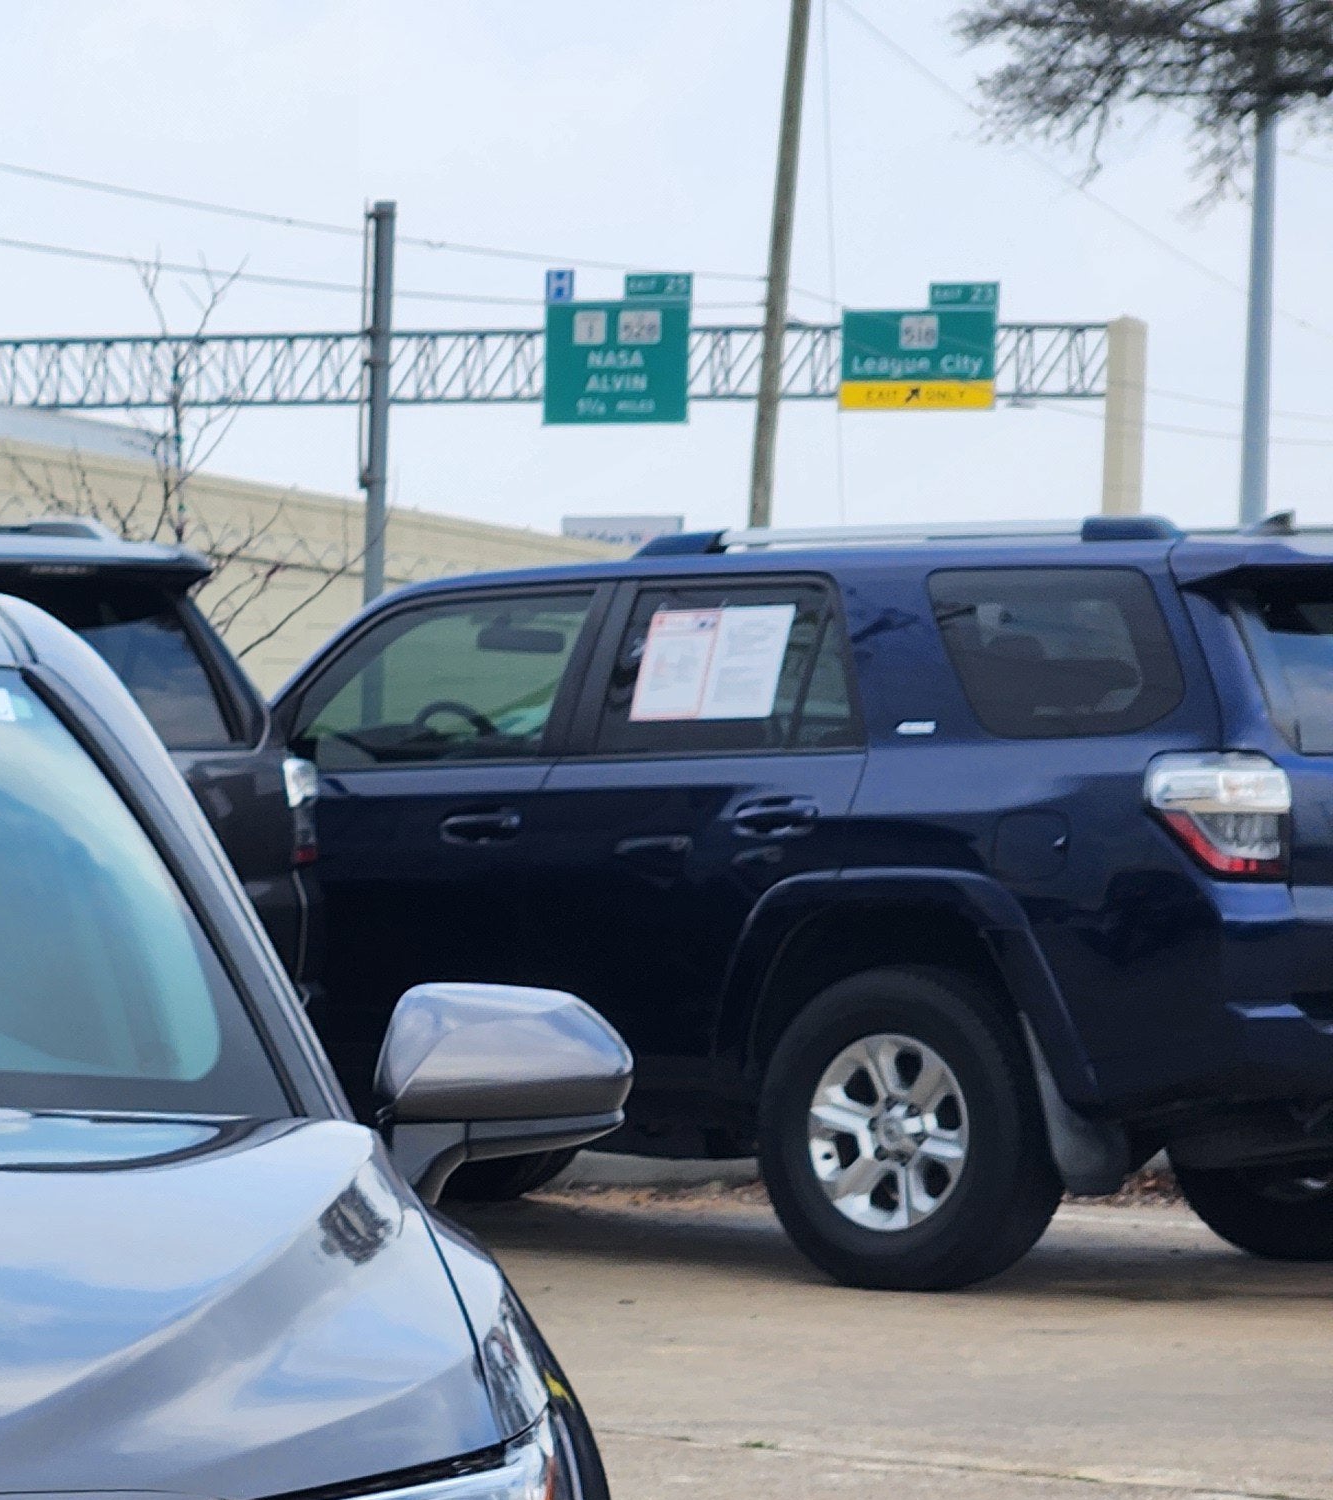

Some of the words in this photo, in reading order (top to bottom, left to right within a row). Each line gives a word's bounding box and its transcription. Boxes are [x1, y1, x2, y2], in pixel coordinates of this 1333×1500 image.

[586, 350, 645, 370] NASA
[850, 354, 931, 378] League
[939, 352, 984, 380] City
[584, 373, 649, 393] ALVIN
[865, 388, 898, 401] EXIT
[926, 387, 965, 401] ONLY
